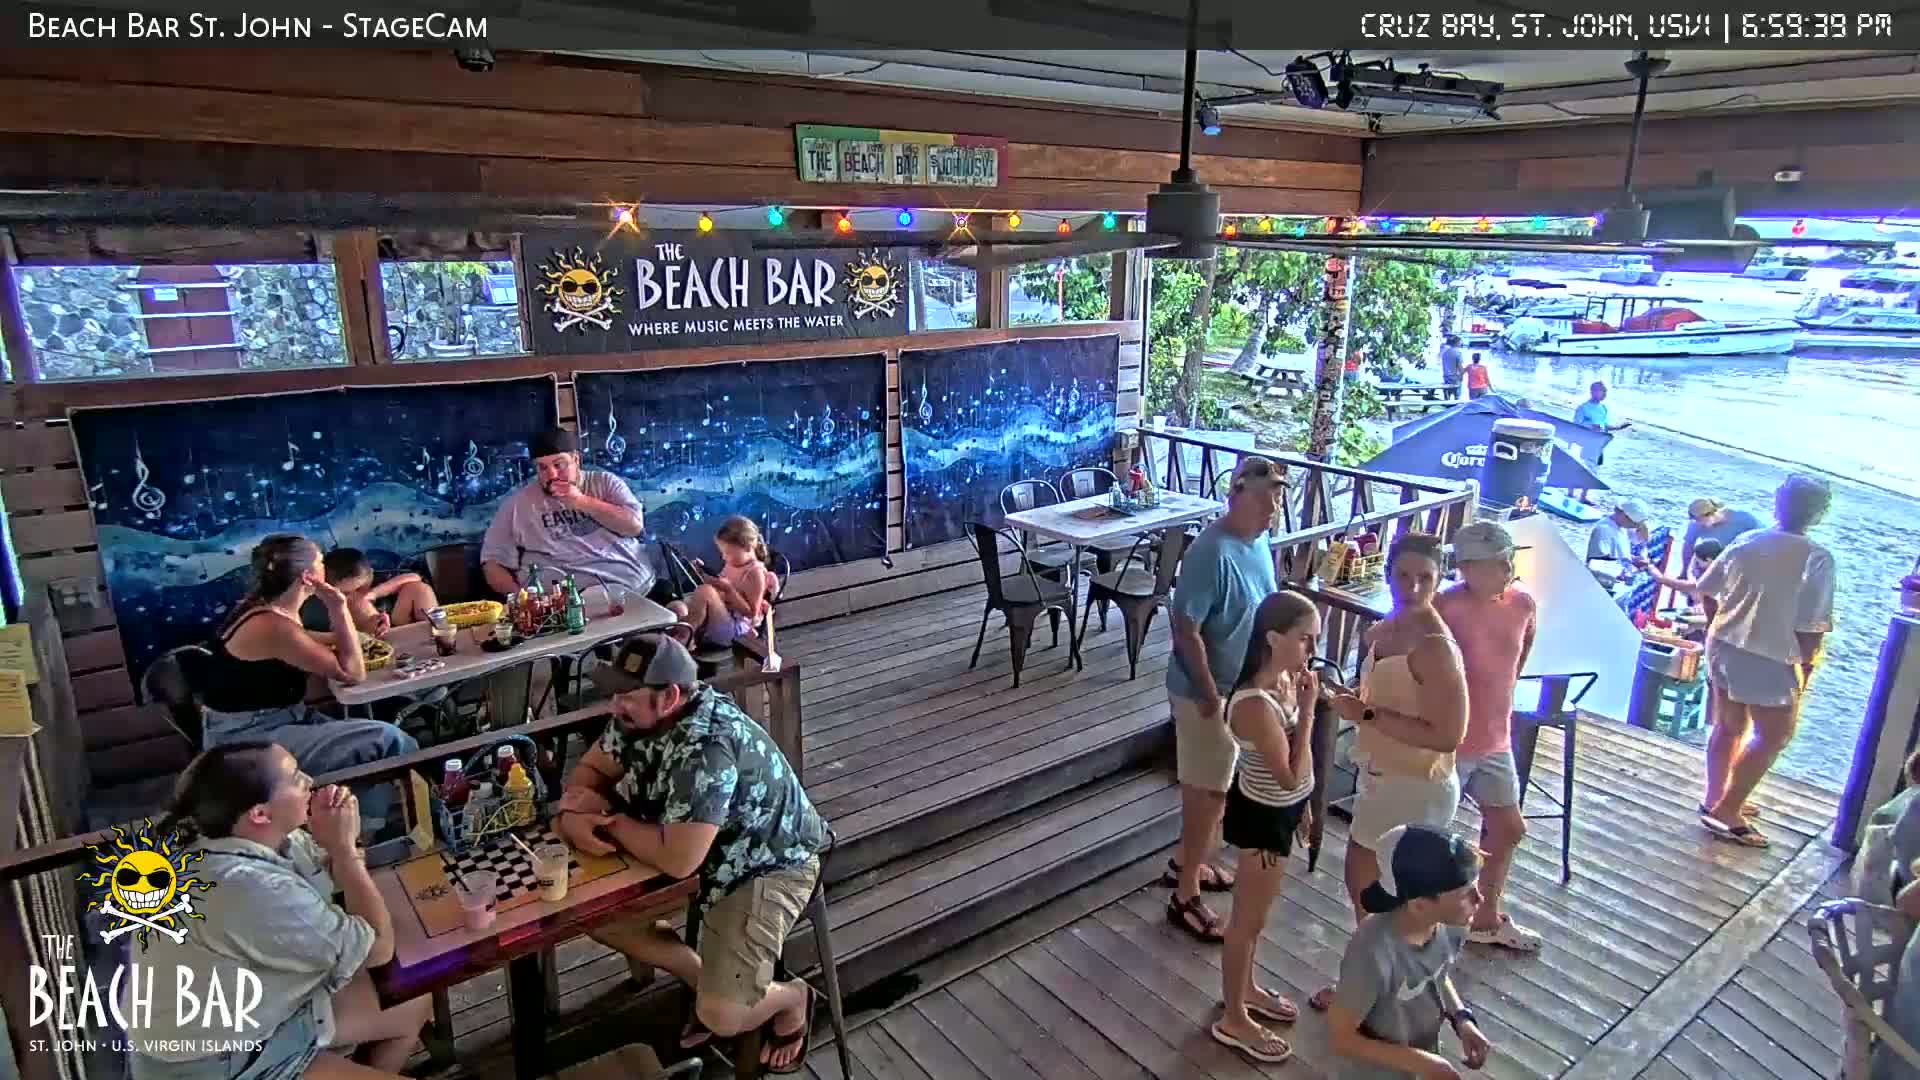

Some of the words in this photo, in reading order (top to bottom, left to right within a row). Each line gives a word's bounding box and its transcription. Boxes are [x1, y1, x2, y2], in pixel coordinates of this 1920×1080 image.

[807, 149, 833, 172] THE
[845, 151, 885, 174] BEACH
[896, 155, 919, 176] BAR
[655, 242, 686, 261] THE
[636, 256, 749, 310] BEACH
[766, 257, 836, 308] BAR
[628, 321, 680, 337] WHERE
[684, 319, 730, 335] MUSIC
[733, 317, 775, 332] MEETS
[777, 316, 801, 329] THE
[804, 314, 845, 328] WATER
